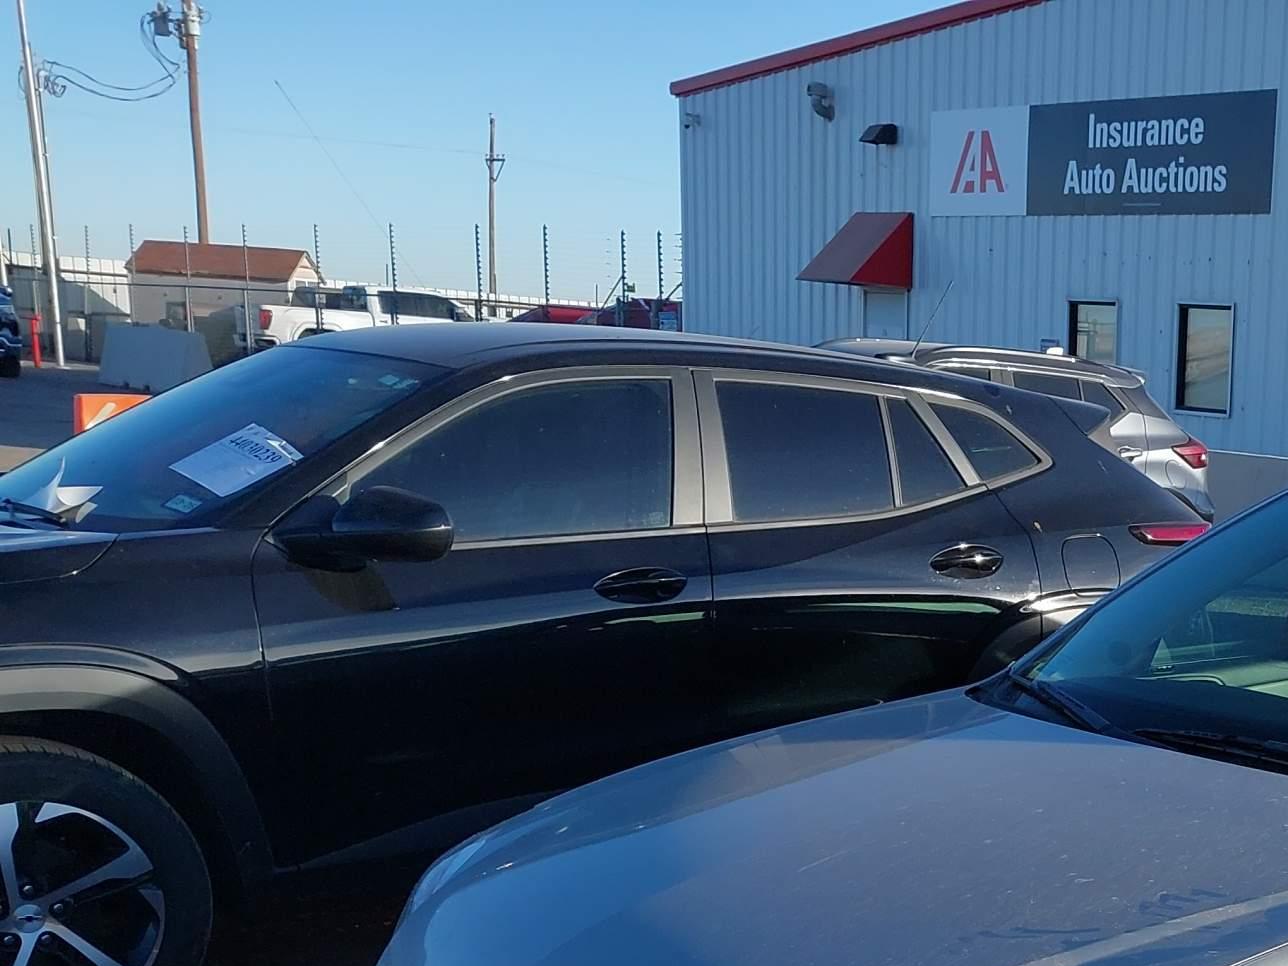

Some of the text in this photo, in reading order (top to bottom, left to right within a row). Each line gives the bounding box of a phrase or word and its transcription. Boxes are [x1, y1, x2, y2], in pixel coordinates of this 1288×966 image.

[1088, 113, 1205, 149] Insurance
[1063, 156, 1227, 195] Auto Auctions
